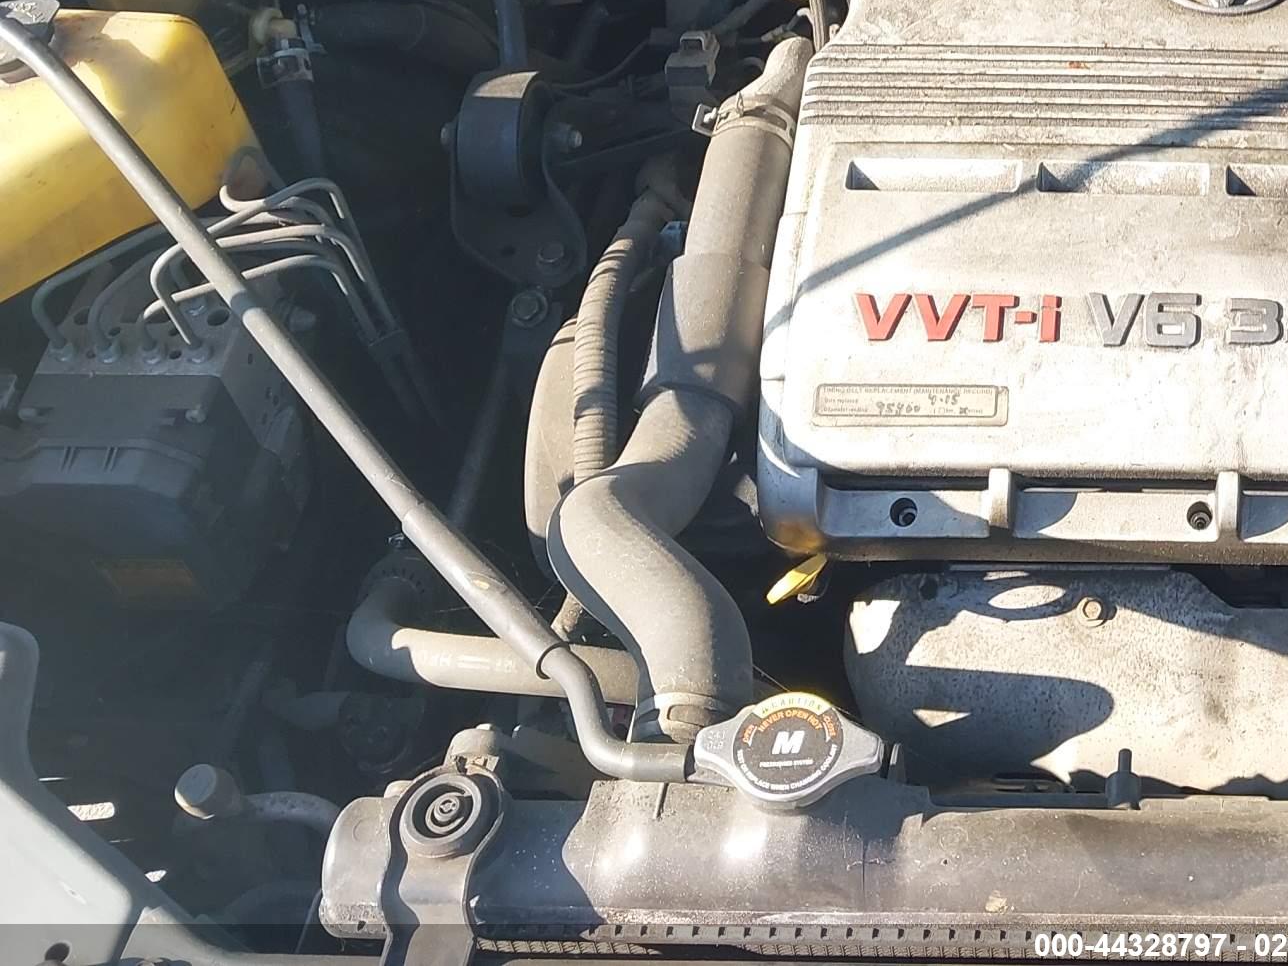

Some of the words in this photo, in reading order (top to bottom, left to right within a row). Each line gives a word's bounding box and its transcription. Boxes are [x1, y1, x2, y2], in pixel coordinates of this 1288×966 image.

[855, 294, 1061, 342] VVT-i
[1089, 293, 1202, 349] V6
[758, 711, 784, 732] NEVER
[785, 710, 808, 719] OPEN
[807, 714, 823, 730] HOT
[772, 730, 805, 754] M
